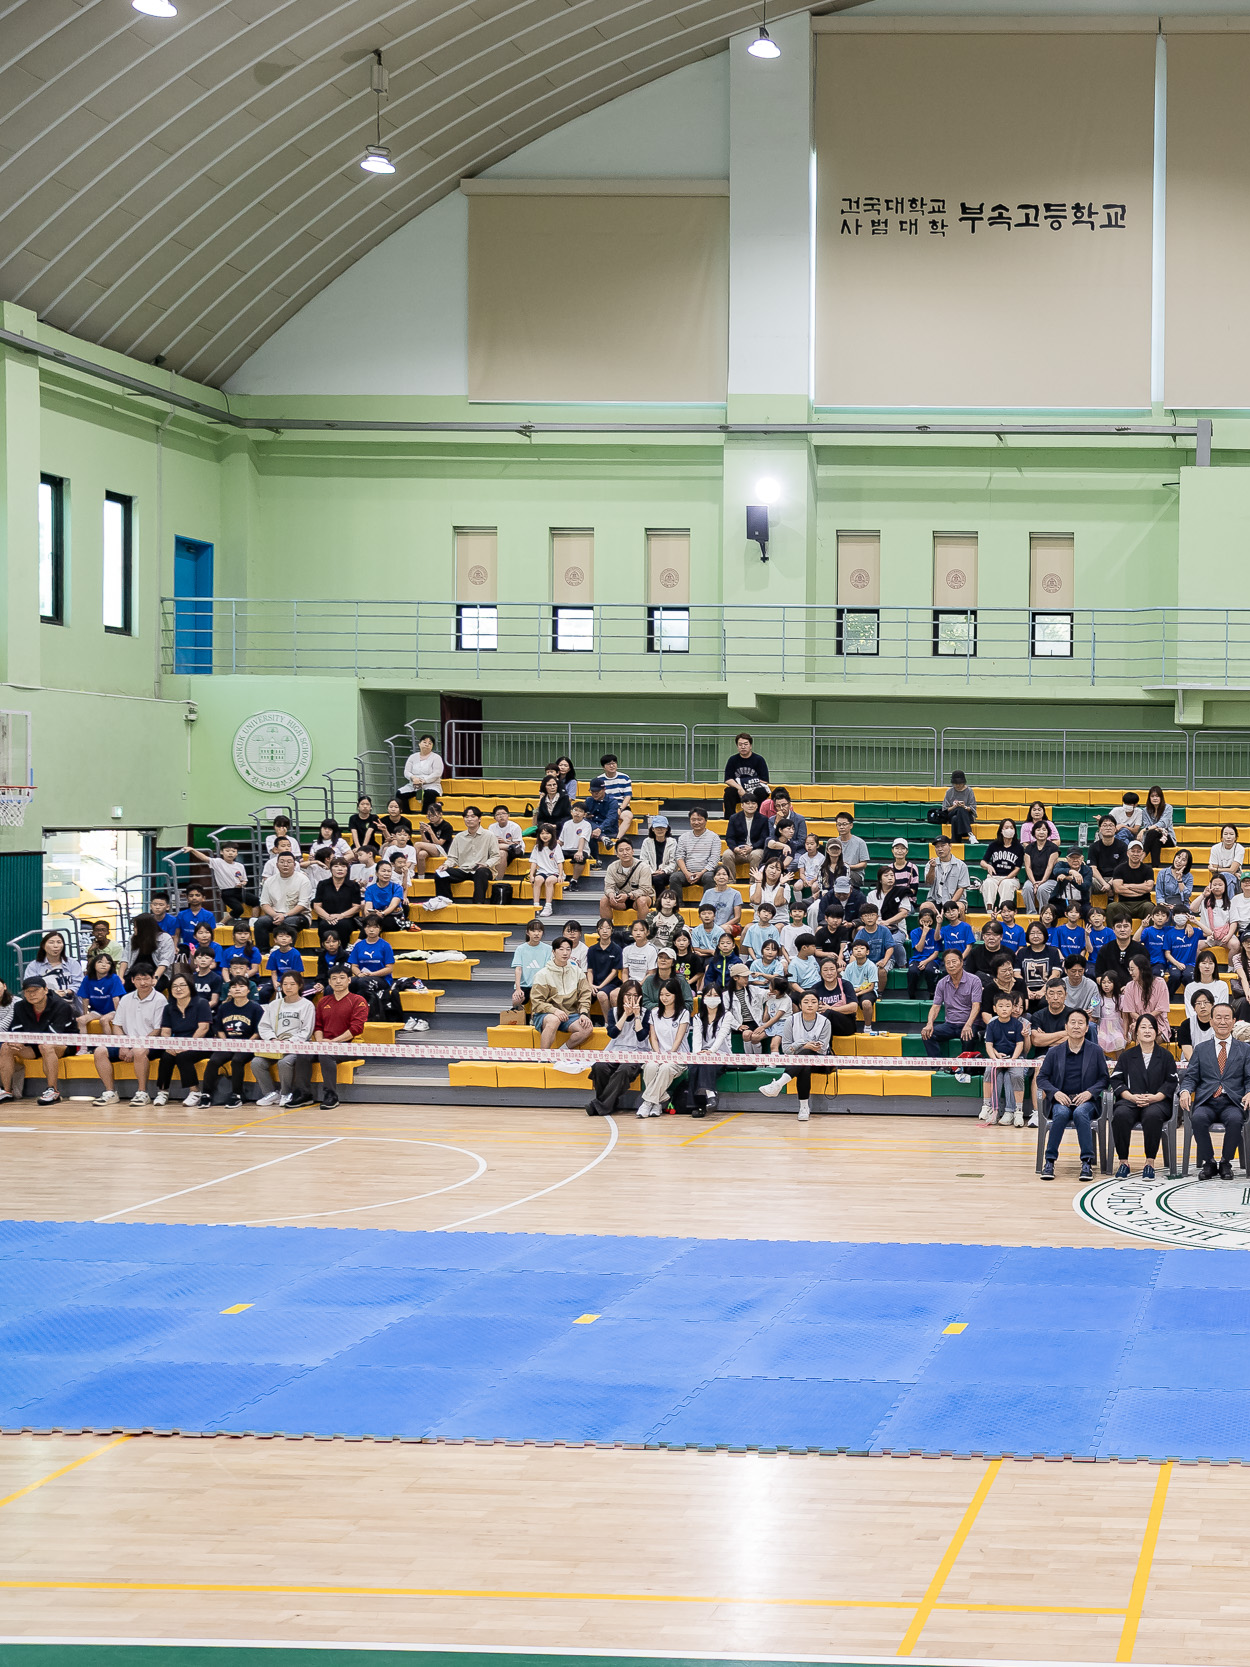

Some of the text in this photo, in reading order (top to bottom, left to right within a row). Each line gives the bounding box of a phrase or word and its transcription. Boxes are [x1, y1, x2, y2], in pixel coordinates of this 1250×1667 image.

[840, 196, 949, 216] 건국대학교
[958, 201, 1127, 234] 부속고등학교
[236, 714, 309, 768] KONKUK UNIVERSITY HIGH SCHOOL
[1107, 1182, 1165, 1216] SCHOOL
[1126, 1217, 1227, 1241] HIGH
